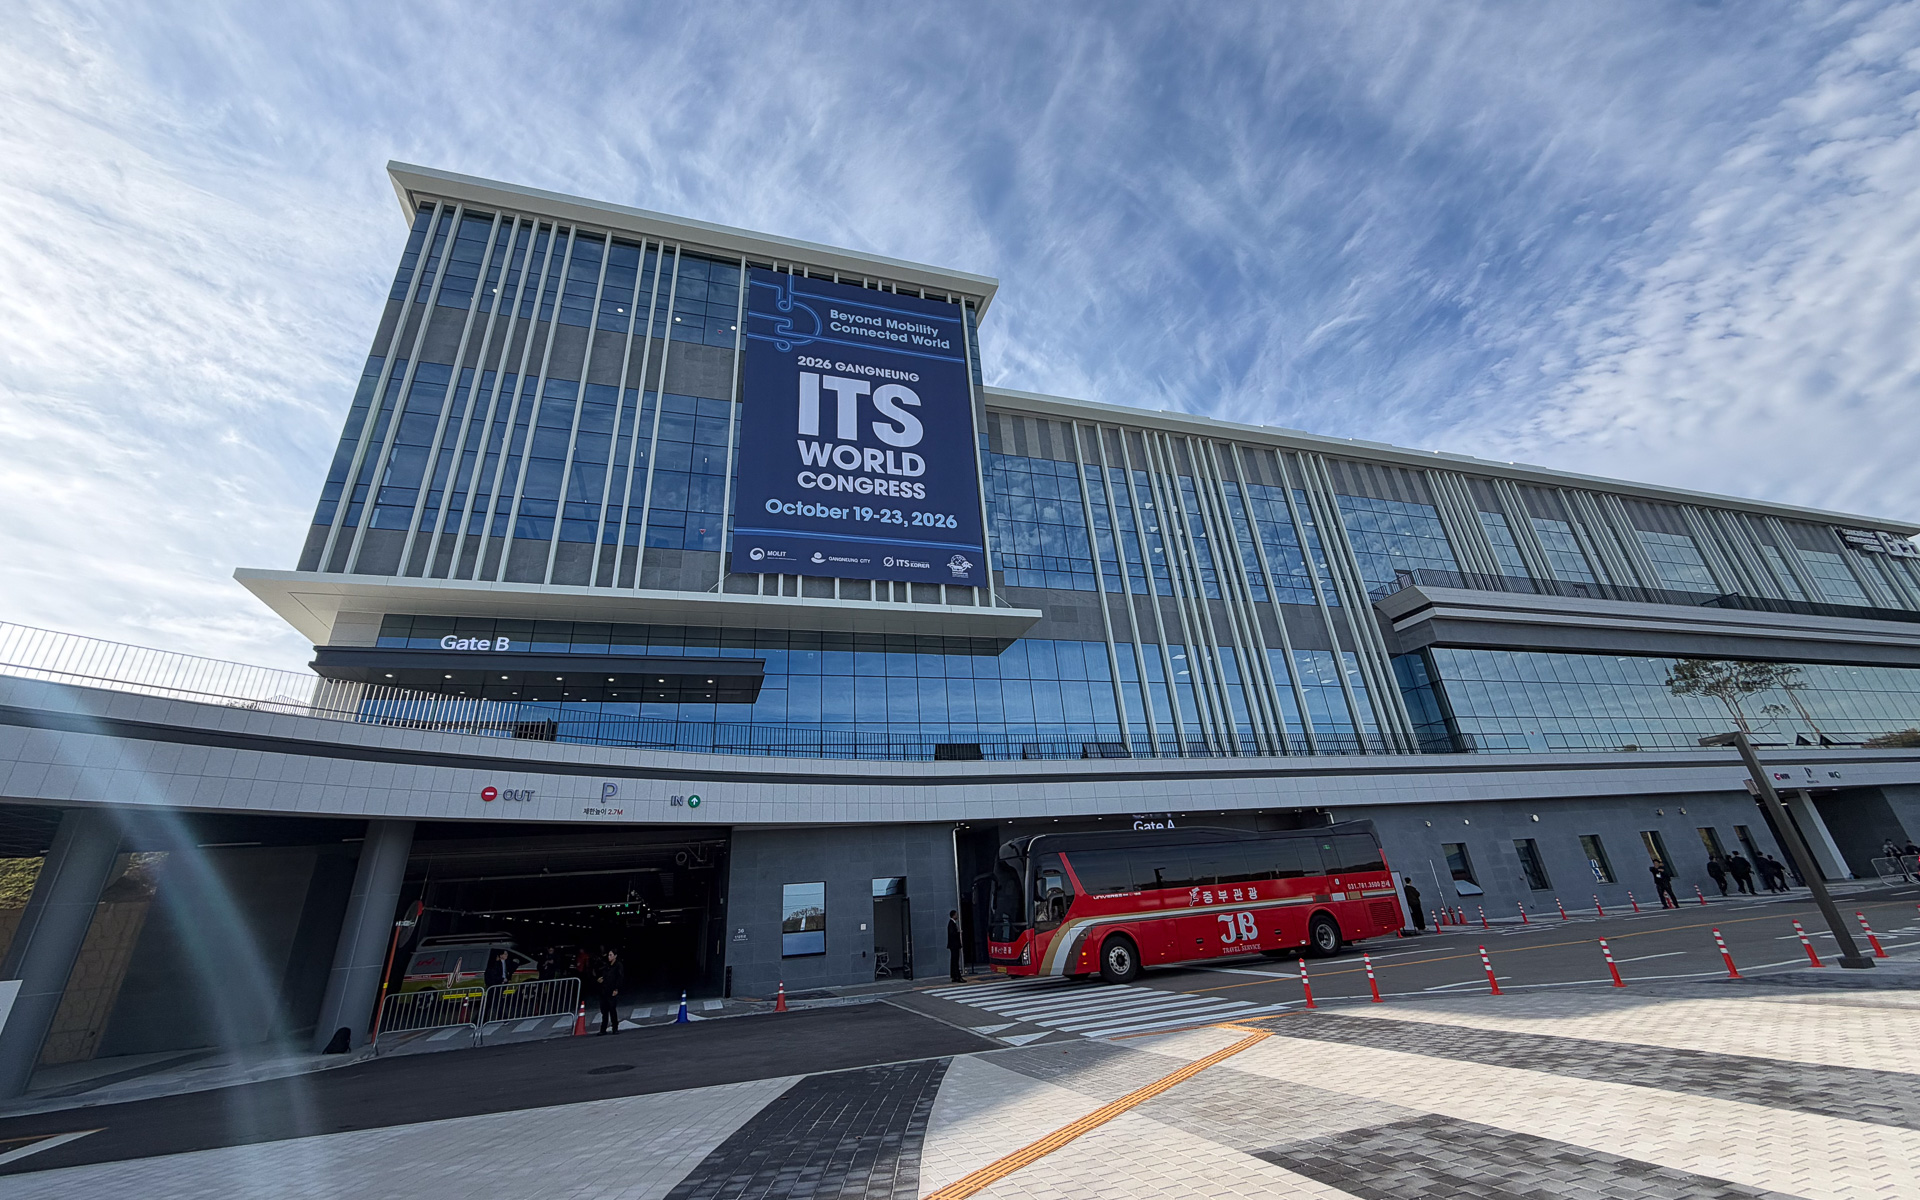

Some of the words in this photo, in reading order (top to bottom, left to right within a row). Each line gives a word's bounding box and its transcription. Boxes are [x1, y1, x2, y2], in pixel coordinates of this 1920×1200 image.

[829, 321, 908, 343] Connected
[911, 334, 950, 349] World
[830, 309, 882, 327] Beyond
[886, 318, 939, 338] Mobility
[797, 355, 832, 370] 2026
[835, 361, 920, 382] GANGNEUNG
[798, 371, 924, 448] ITS
[796, 439, 926, 477] WORLD
[797, 470, 926, 500] CONGRESS
[765, 498, 850, 520] October
[853, 506, 909, 528] 19-23,
[911, 511, 958, 529] 2026
[896, 558, 910, 568] ITS
[440, 634, 491, 651] Gate
[495, 636, 510, 651] B
[502, 788, 535, 802] OUT
[601, 782, 619, 804] P
[670, 795, 685, 807] IN
[583, 807, 607, 815] 제한높이
[607, 808, 624, 816] 2.7M
[1203, 887, 1258, 904] 중부관광
[1217, 911, 1258, 944] JB
[1222, 945, 1241, 954] TRAVEL
[1241, 943, 1261, 952] SERVICE
